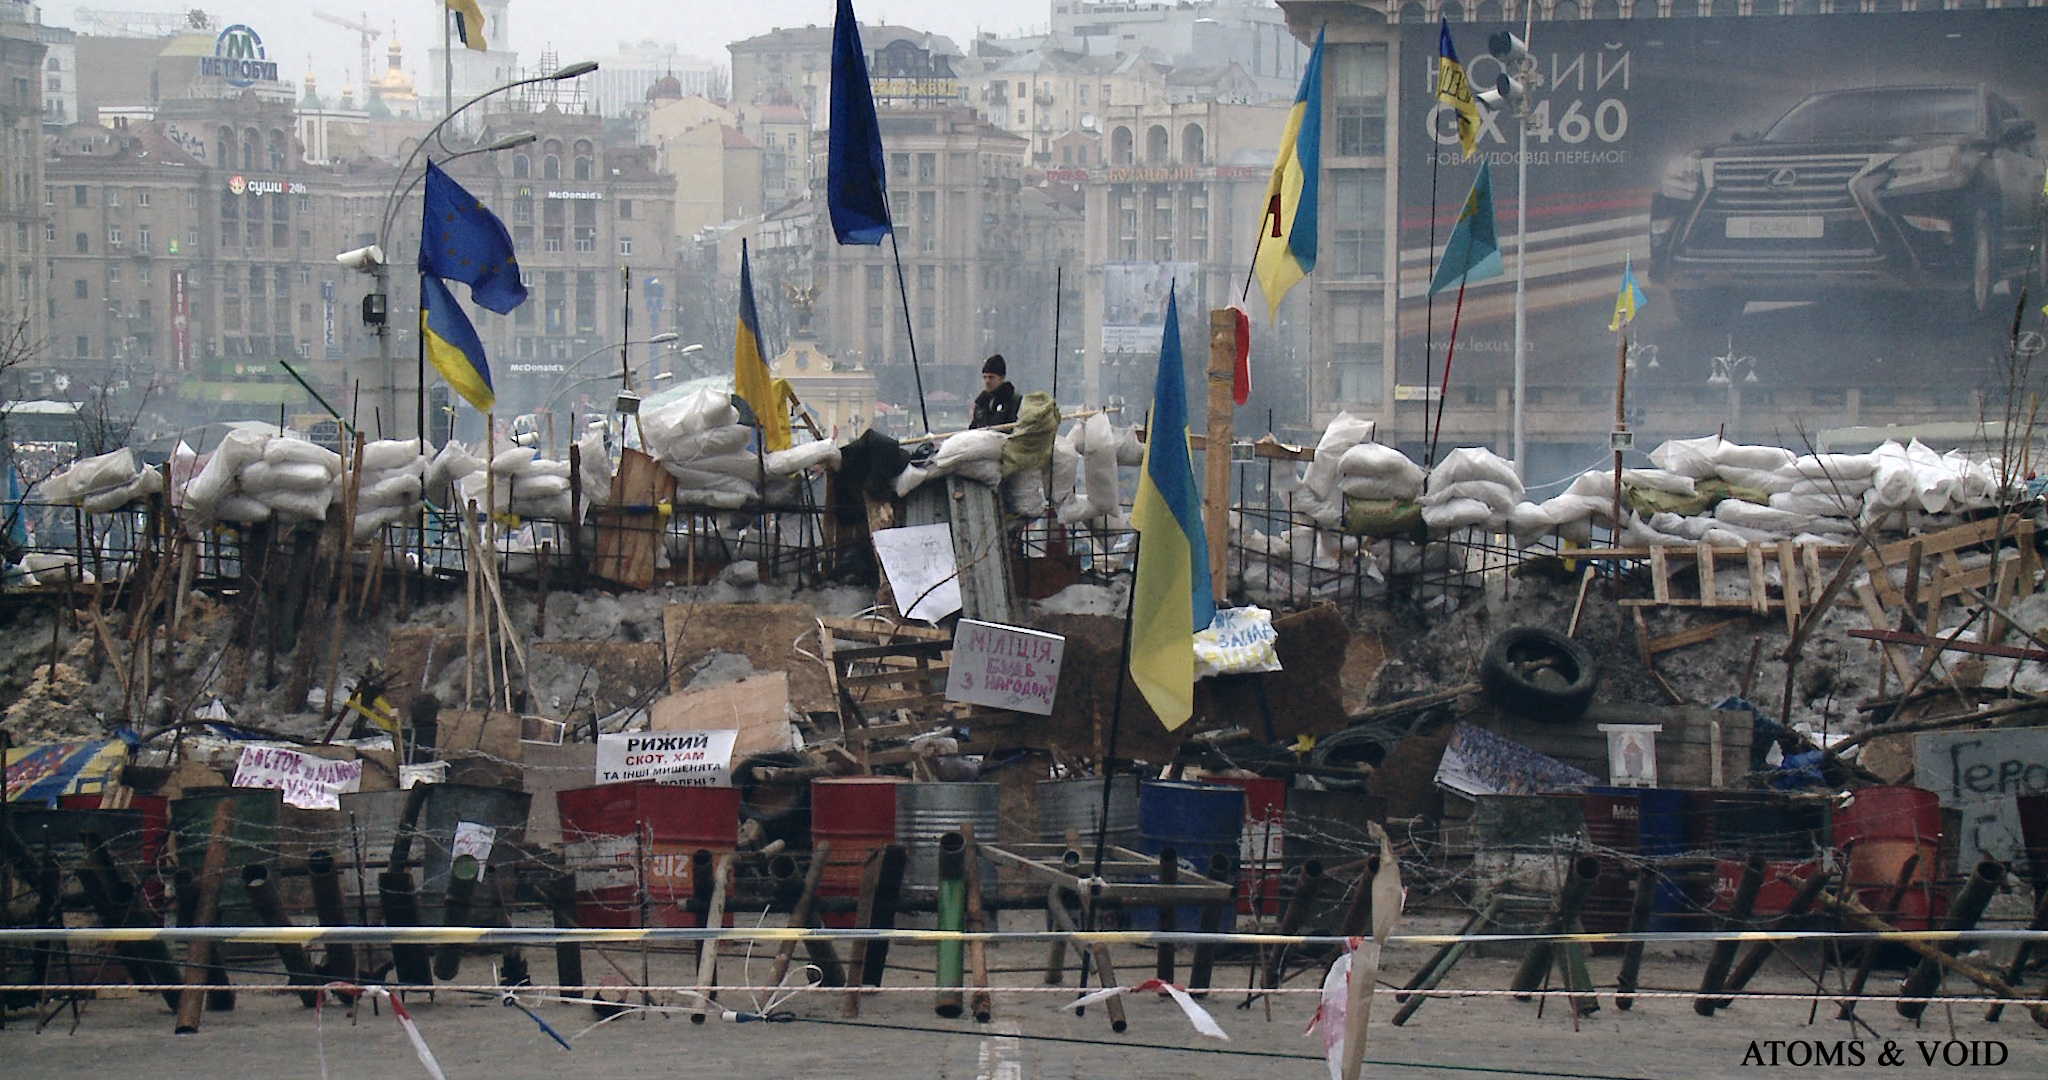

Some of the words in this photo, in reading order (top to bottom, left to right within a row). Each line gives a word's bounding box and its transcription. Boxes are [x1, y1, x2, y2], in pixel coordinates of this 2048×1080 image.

[1526, 98, 1628, 143] 460
[1555, 150, 1625, 164] ПЕРЕМОГ
[548, 191, 602, 200] McDonald's
[510, 364, 564, 372] McDonald's
[986, 657, 1036, 677] БУДЬ
[627, 733, 708, 752] РИЖИЙ
[626, 754, 668, 766] СКОТ,
[673, 751, 705, 762] ХАМ
[604, 771, 619, 780] ТА
[623, 768, 649, 779] ІНШІ
[652, 763, 721, 775] МИШЕНЯТА
